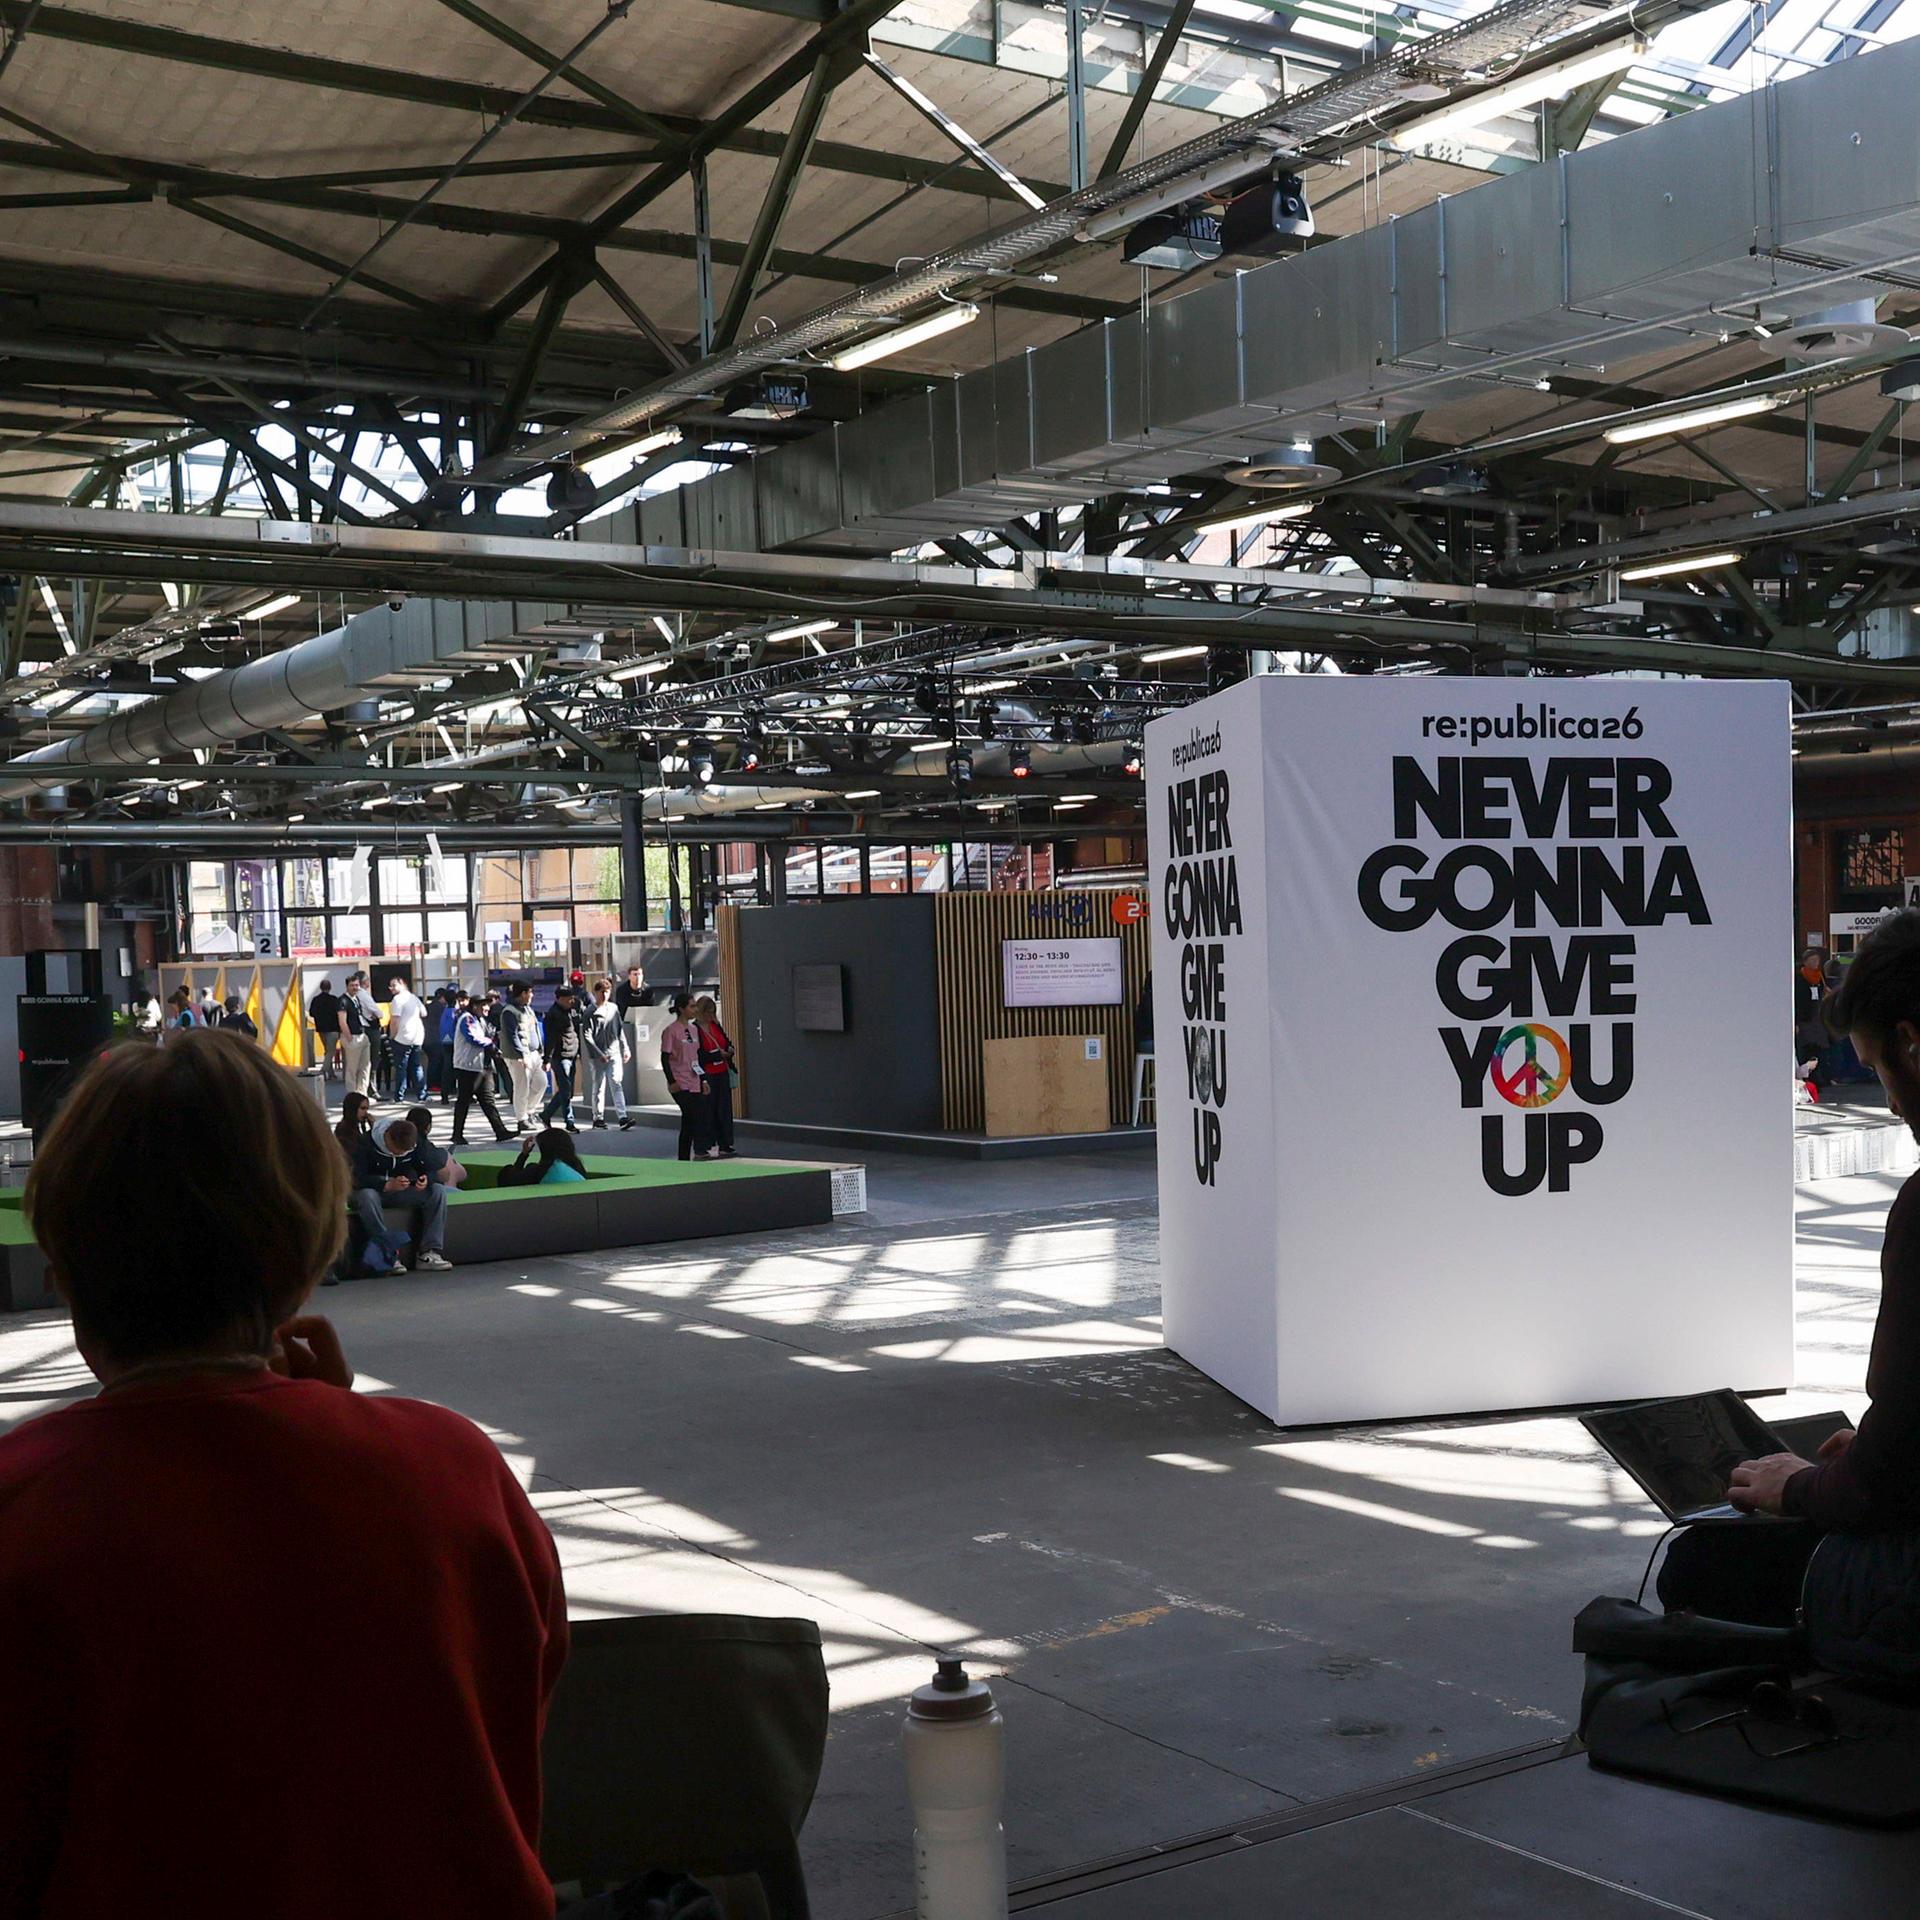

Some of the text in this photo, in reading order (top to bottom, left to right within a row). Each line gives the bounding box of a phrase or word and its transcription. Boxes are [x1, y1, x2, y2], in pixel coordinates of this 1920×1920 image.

[1173, 720, 1221, 772] re:publica26
[1423, 703, 1643, 748] re:publica26
[1168, 770, 1232, 858] NEVER
[1392, 756, 1679, 839] NEVER
[1165, 855, 1242, 940] GONNA
[1358, 845, 1712, 932] GONNA
[260, 938, 271, 953] 2
[1014, 952, 1038, 960] 12:30
[1046, 951, 1070, 960] 13:30
[1181, 943, 1226, 1022] GIVE
[1436, 934, 1637, 1020] GIVE
[1183, 1025, 1226, 1109] YOU
[1437, 1022, 1634, 1109] YOU
[1193, 1107, 1221, 1187] UP
[1481, 1112, 1603, 1197] UP
